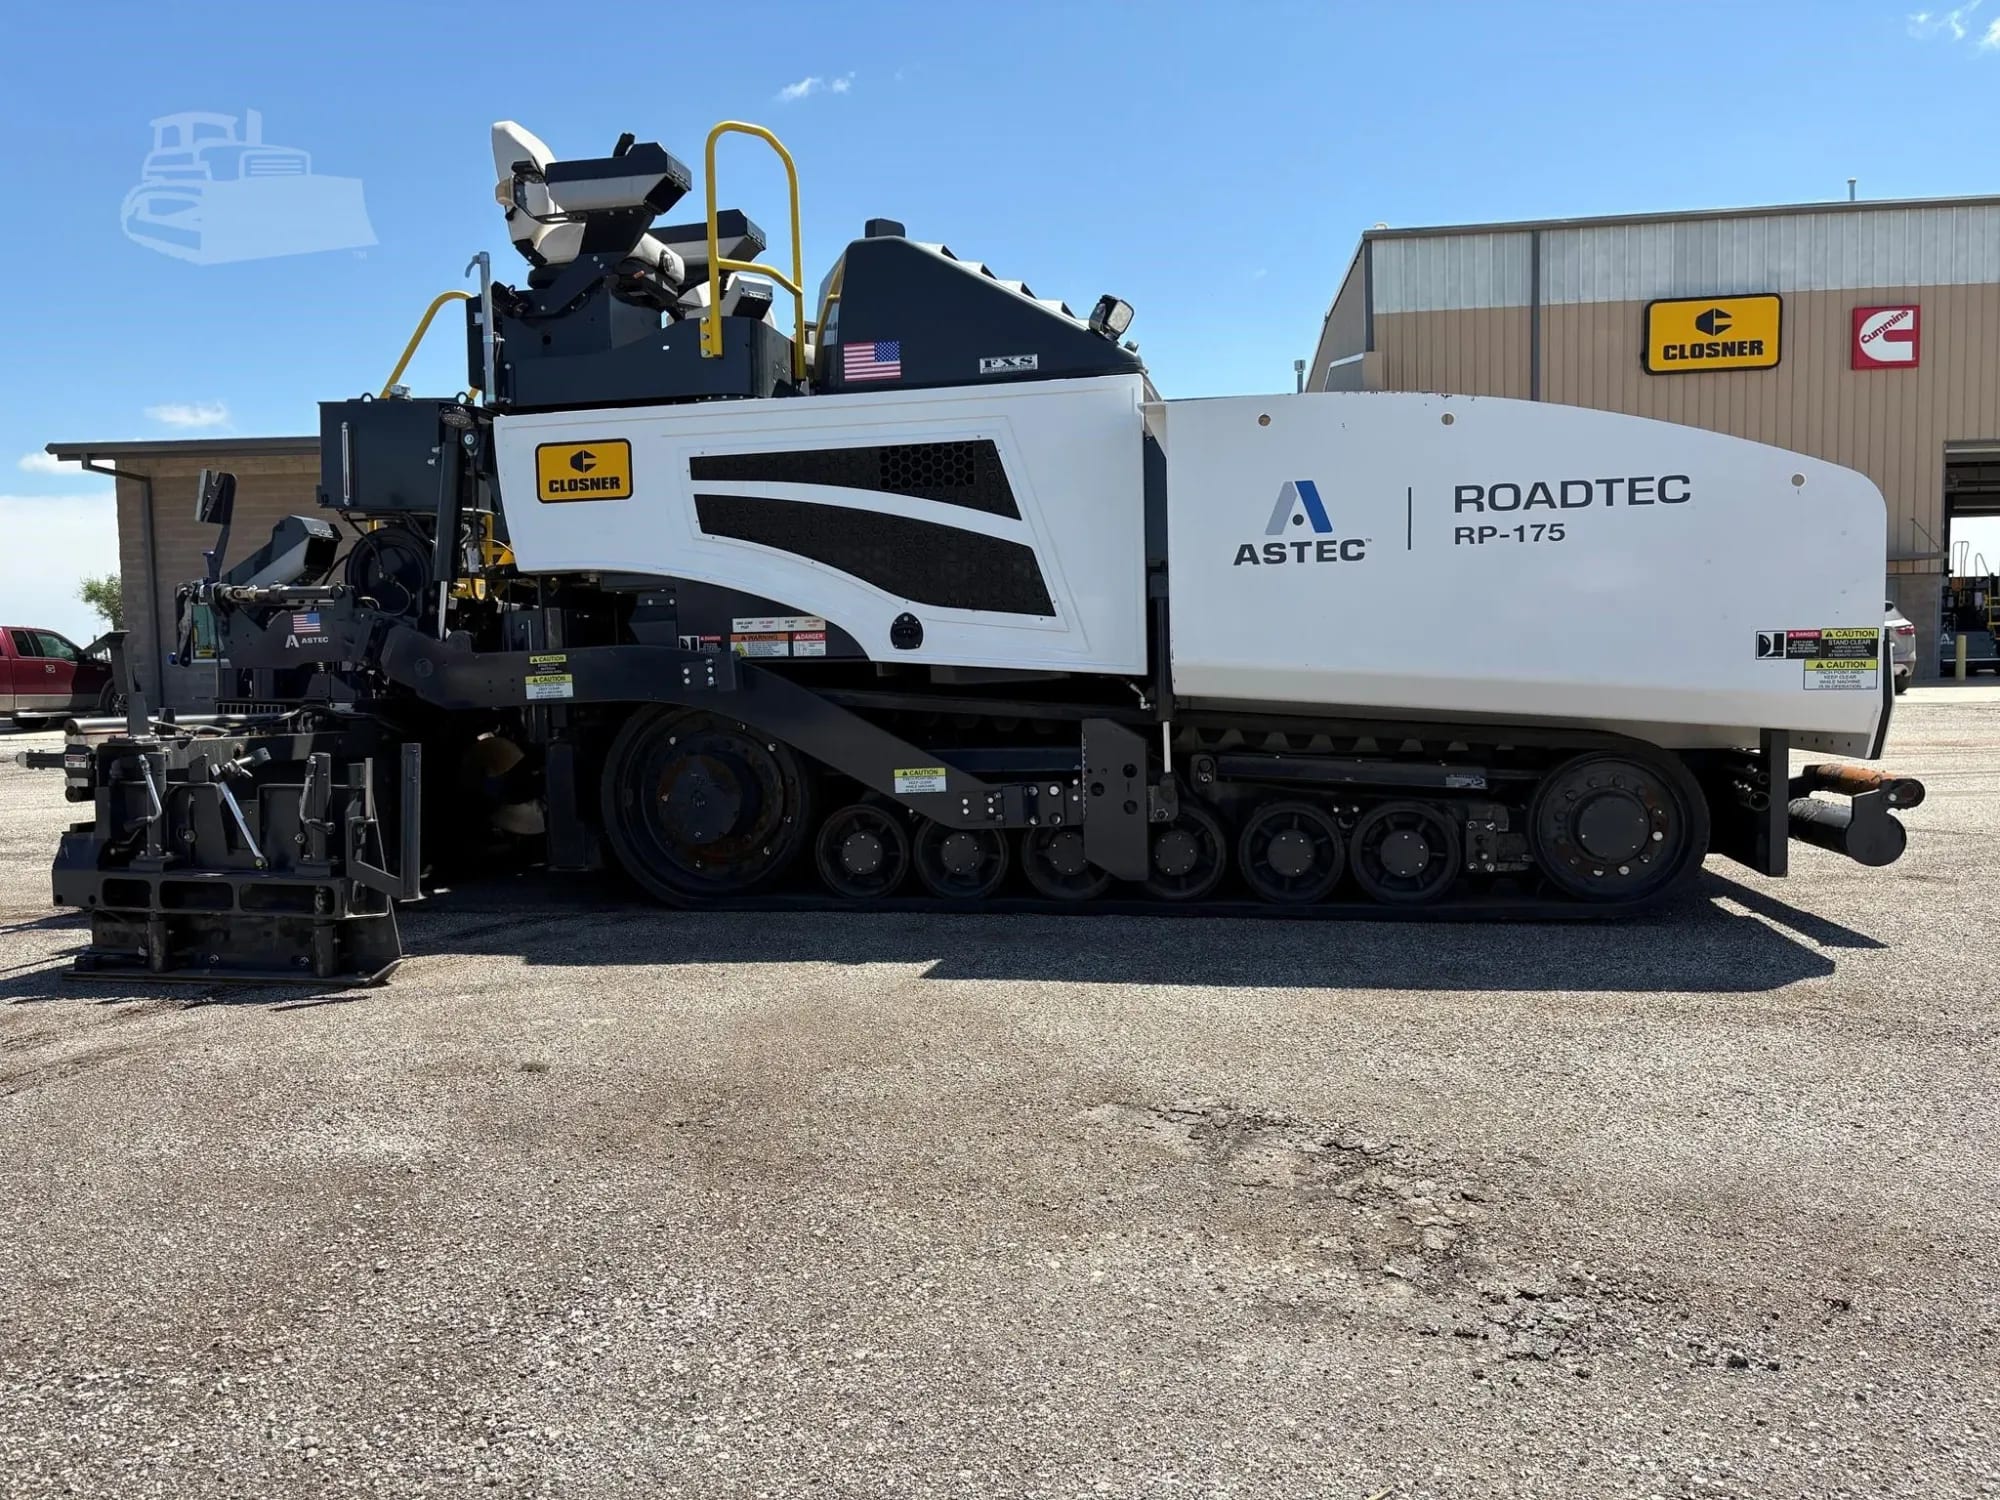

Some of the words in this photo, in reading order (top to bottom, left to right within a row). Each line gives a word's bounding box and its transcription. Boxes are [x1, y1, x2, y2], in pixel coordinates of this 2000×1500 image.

[1860, 310, 1909, 344] Cummins
[1663, 339, 1764, 361] CLOSNER
[548, 476, 620, 493] CLOSNER
[1453, 475, 1692, 513] ROADTEC
[1453, 522, 1566, 545] RP-175
[1233, 538, 1366, 566] ASTEC
[301, 636, 329, 644] ASTEC
[1835, 630, 1875, 638] CAUTION
[1826, 661, 1867, 669] CAUTION
